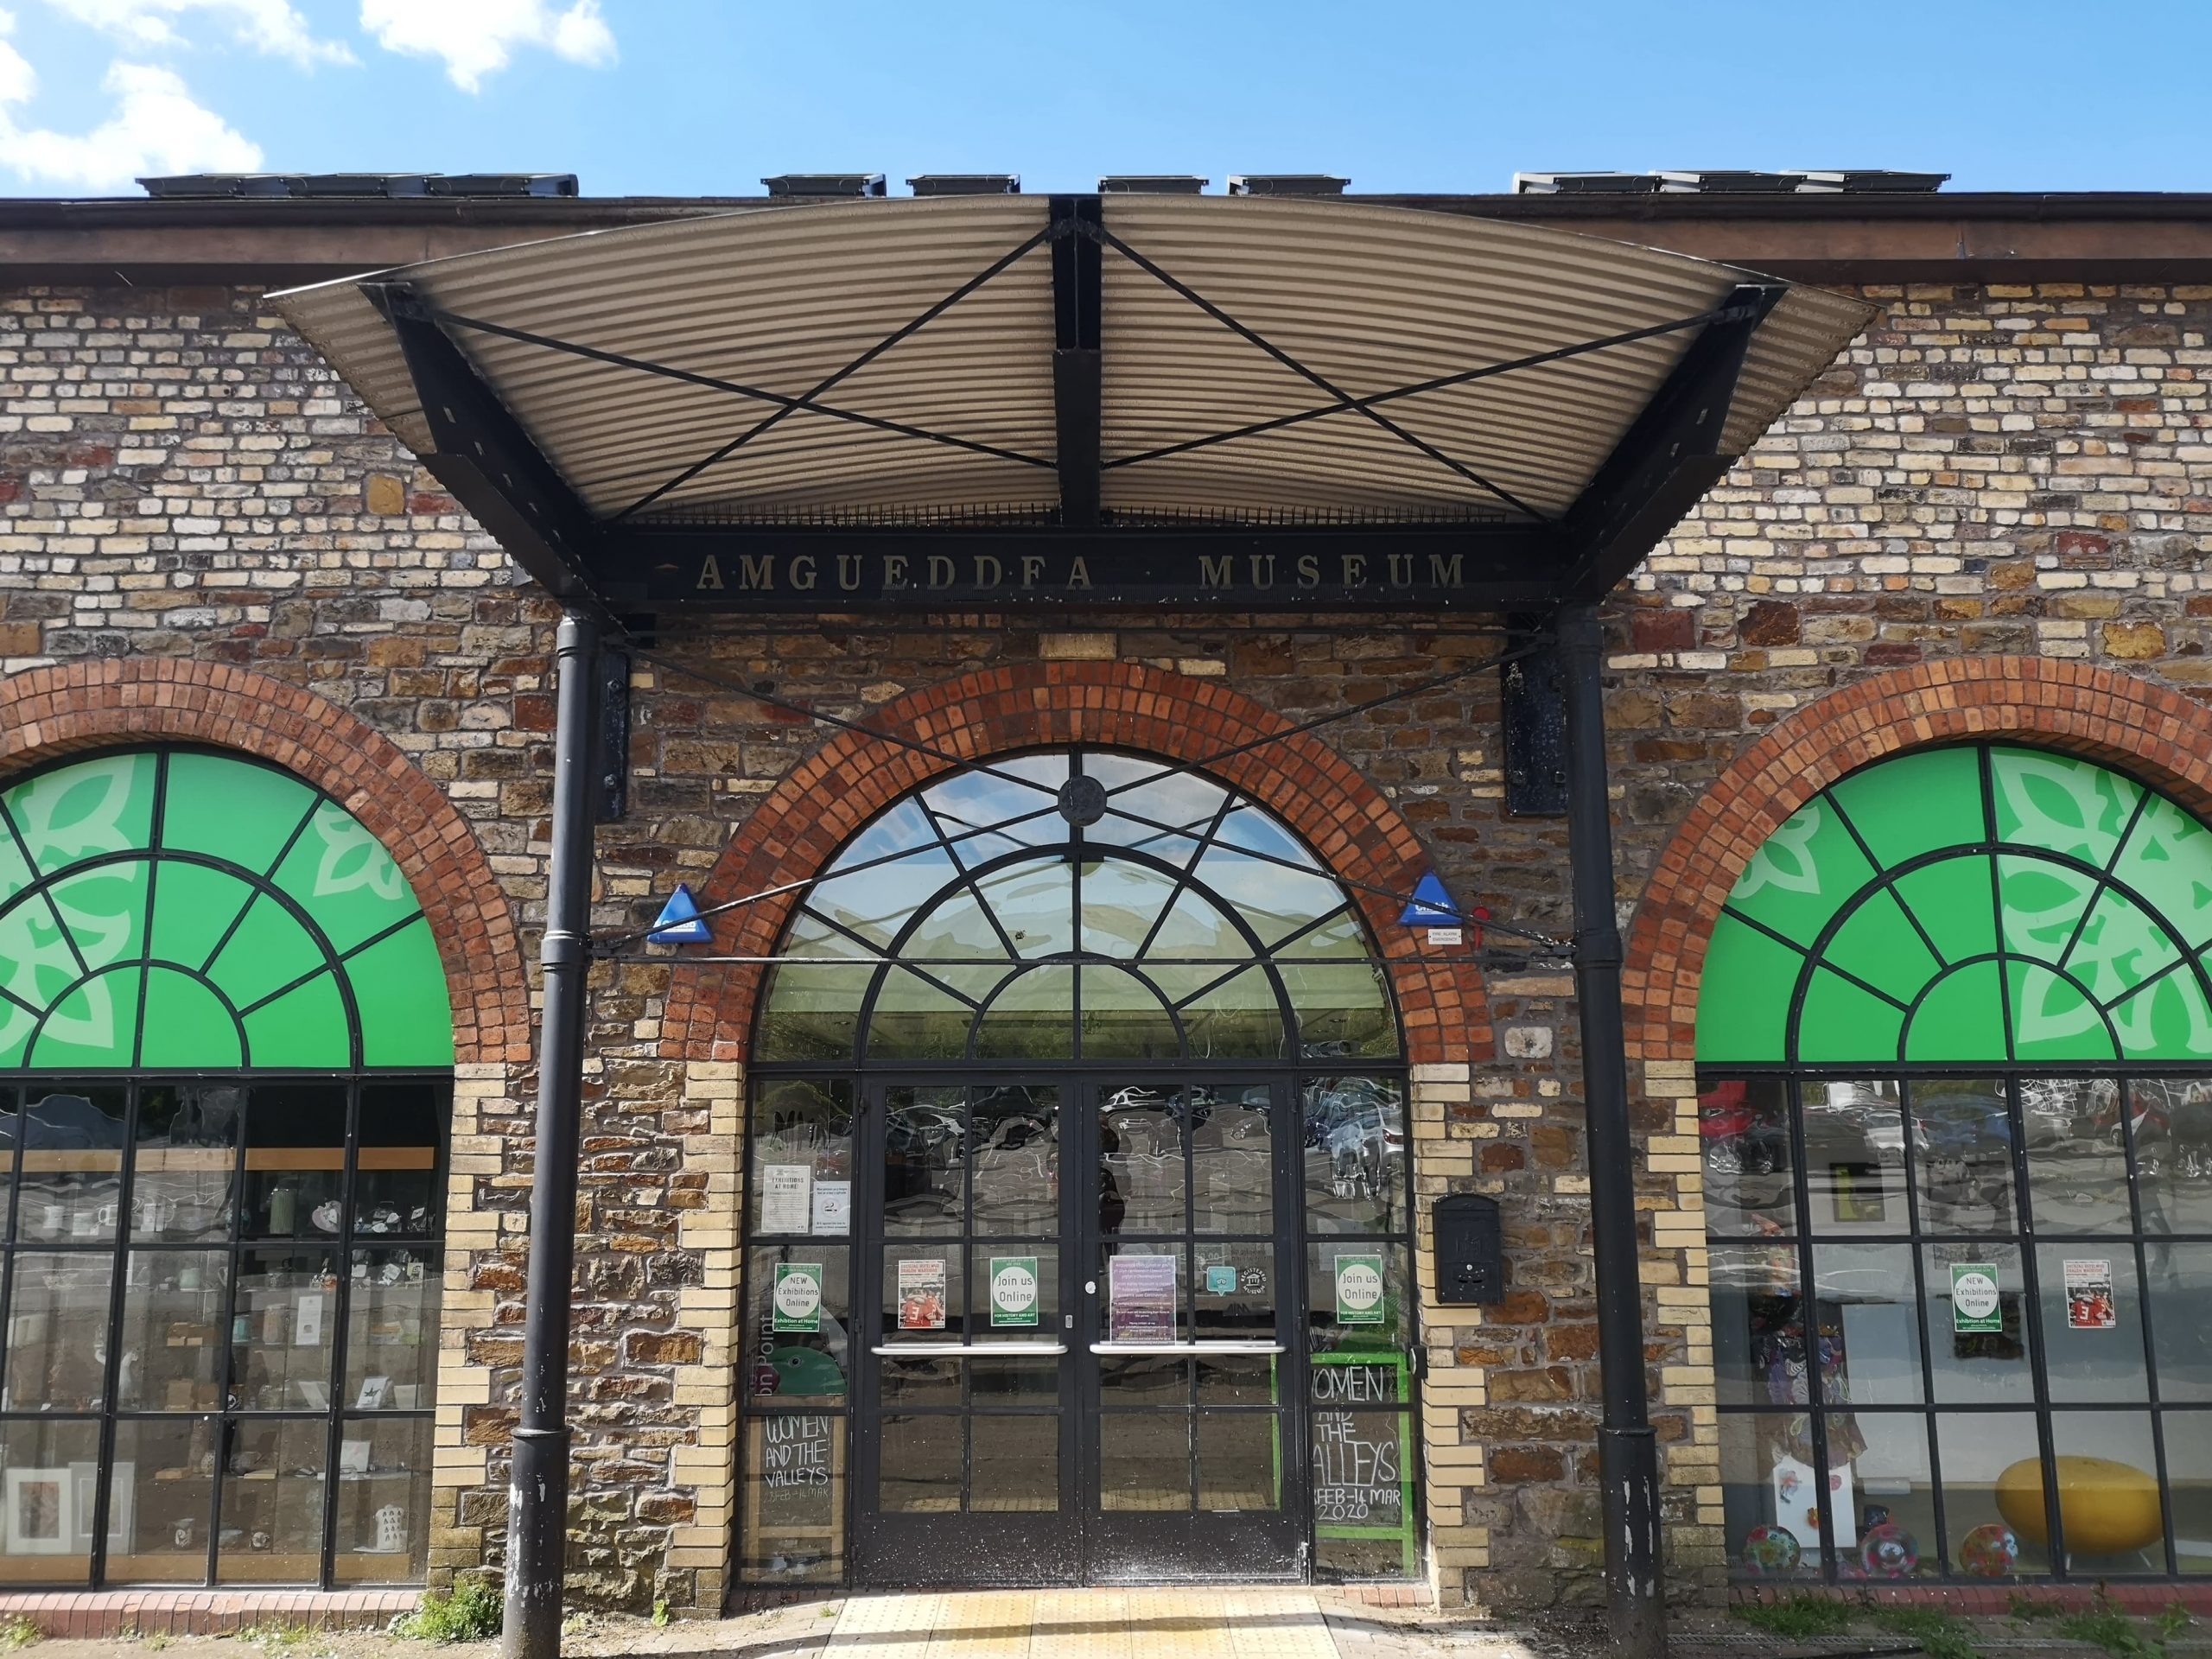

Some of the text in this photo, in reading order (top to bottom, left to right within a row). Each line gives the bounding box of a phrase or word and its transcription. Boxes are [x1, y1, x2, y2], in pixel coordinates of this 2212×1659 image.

[696, 554, 1465, 590] AMGUEDDFA MUSEUM
[998, 1275, 1033, 1287] Join us
[1241, 1268, 1267, 1282] REGISTERED
[1343, 1273, 1378, 1284] Join us
[1000, 1291, 1032, 1302] Online
[1243, 1285, 1266, 1294] MUSEUM
[1344, 1288, 1377, 1300] Online
[1955, 1287, 1997, 1296] Exhibitions
[786, 1298, 810, 1306] Online
[1965, 1299, 1989, 1307] Online
[758, 1314, 774, 1367] Point
[1311, 1365, 1383, 1402] OMEN
[766, 1415, 829, 1444] WOMEN
[1315, 1422, 1357, 1443] THE
[766, 1439, 828, 1468] AND THE
[1313, 1441, 1395, 1486] ALLEYS
[765, 1466, 829, 1488] VALLEYS
[1370, 1489, 1402, 1507] MAR
[1317, 1503, 1369, 1521] 2020
